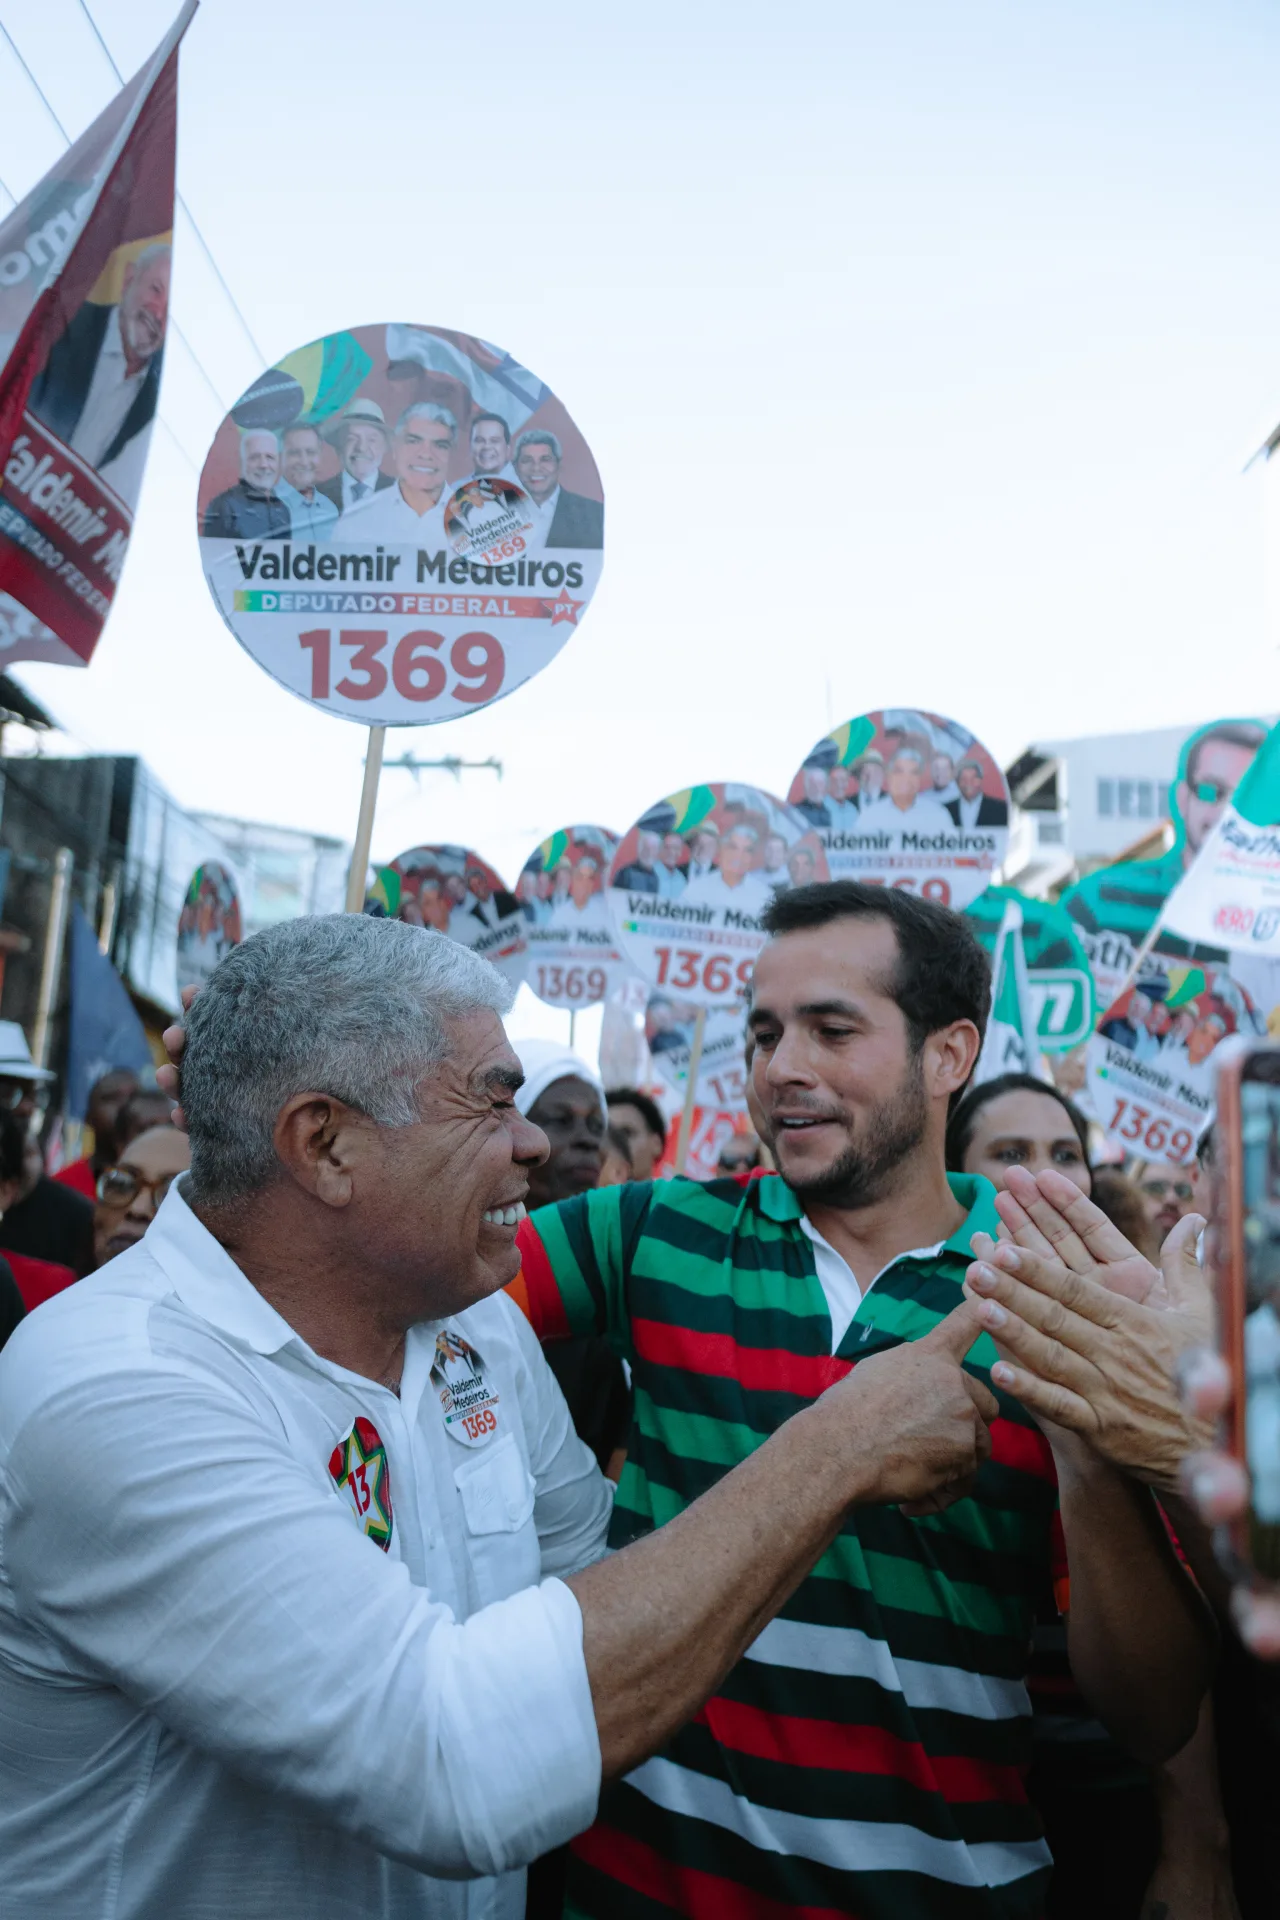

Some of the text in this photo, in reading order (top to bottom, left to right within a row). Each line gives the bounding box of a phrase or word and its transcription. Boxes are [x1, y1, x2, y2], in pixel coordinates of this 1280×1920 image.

[3, 434, 109, 545] aldemir
[465, 509, 516, 538] Valdemir
[471, 520, 522, 548] Medeiros
[235, 544, 401, 581] Valdemir
[481, 536, 526, 566] 1369
[261, 593, 575, 616] DEPUTADO FEDERAL PT
[298, 627, 506, 704] 1369
[901, 830, 996, 851] Medeiros
[627, 893, 717, 926] Valdemir
[536, 965, 608, 1000] 1369
[1109, 1097, 1194, 1162] 1369
[447, 1376, 483, 1396] Valdemir
[453, 1388, 490, 1411] Medeiros
[462, 1409, 497, 1440] 1369
[347, 1462, 371, 1517] 13
